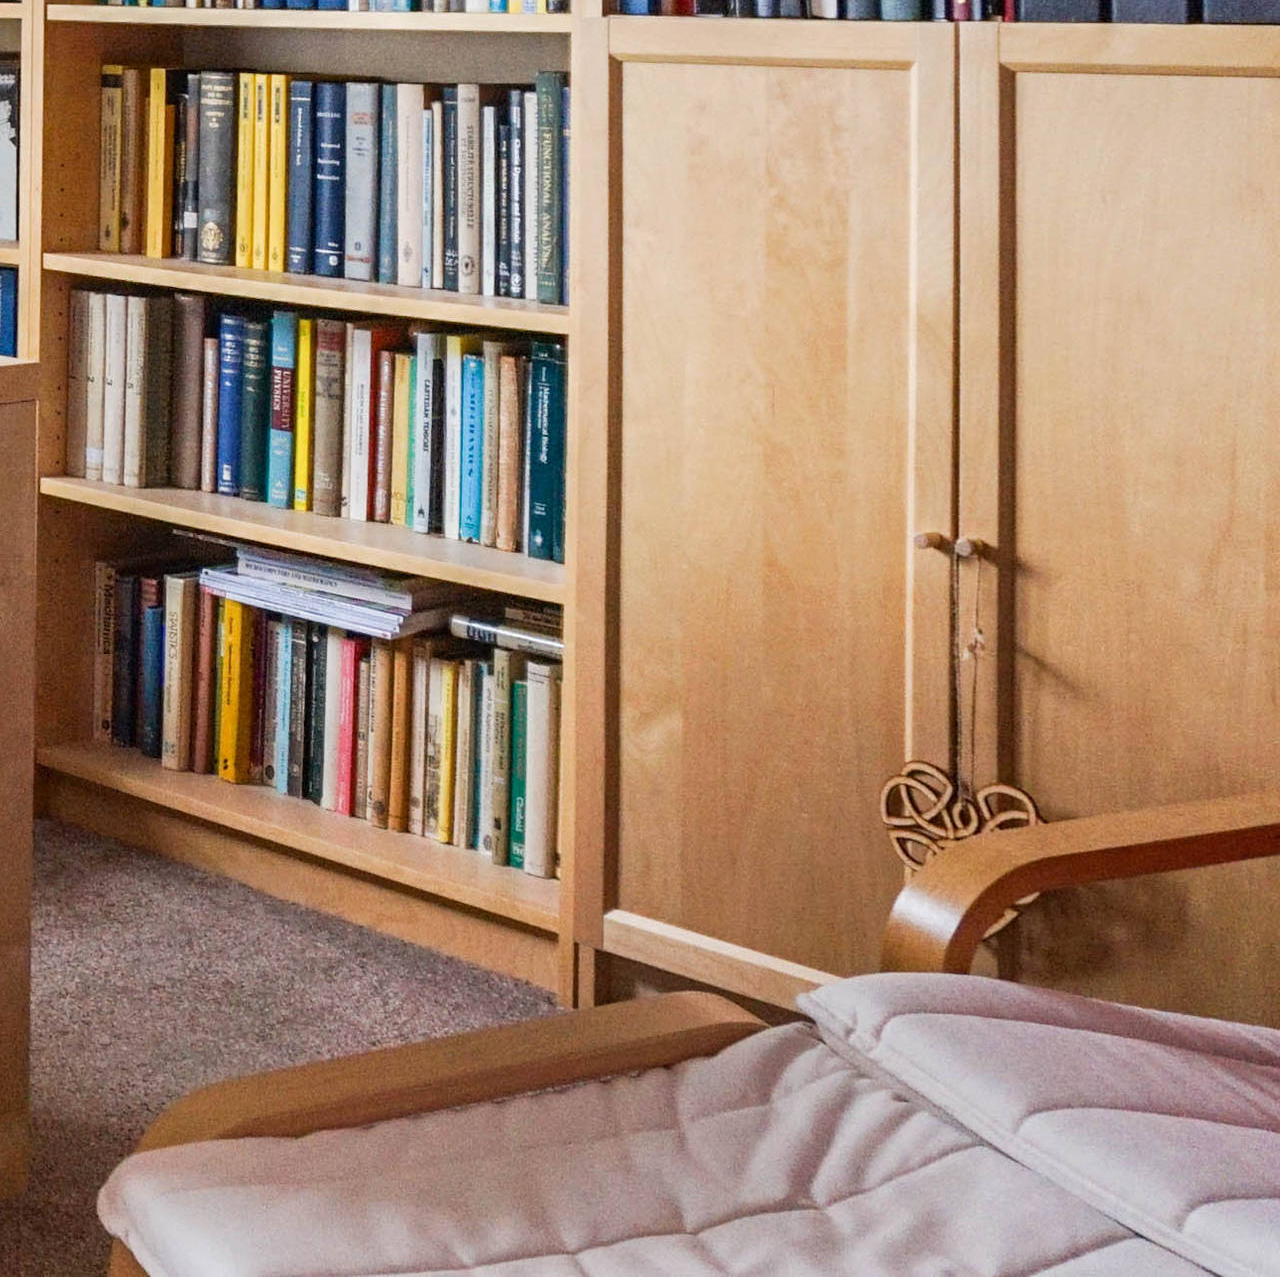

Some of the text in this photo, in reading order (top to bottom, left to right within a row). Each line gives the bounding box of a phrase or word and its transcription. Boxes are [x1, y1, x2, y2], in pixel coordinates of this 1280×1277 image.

[513, 138, 521, 244] Chaotic Dynamics and Fractals
[542, 133, 552, 207] FUNCTIONAL
[272, 369, 282, 411] PHYSICS
[281, 371, 292, 430] UNIVERSITY
[423, 379, 432, 453] CARTESIAN TENSORS
[540, 387, 550, 464] Mathematical Biology
[103, 584, 115, 655] Mechanics
[168, 611, 179, 660] STATISTICS
[515, 796, 524, 832] Chatfield
